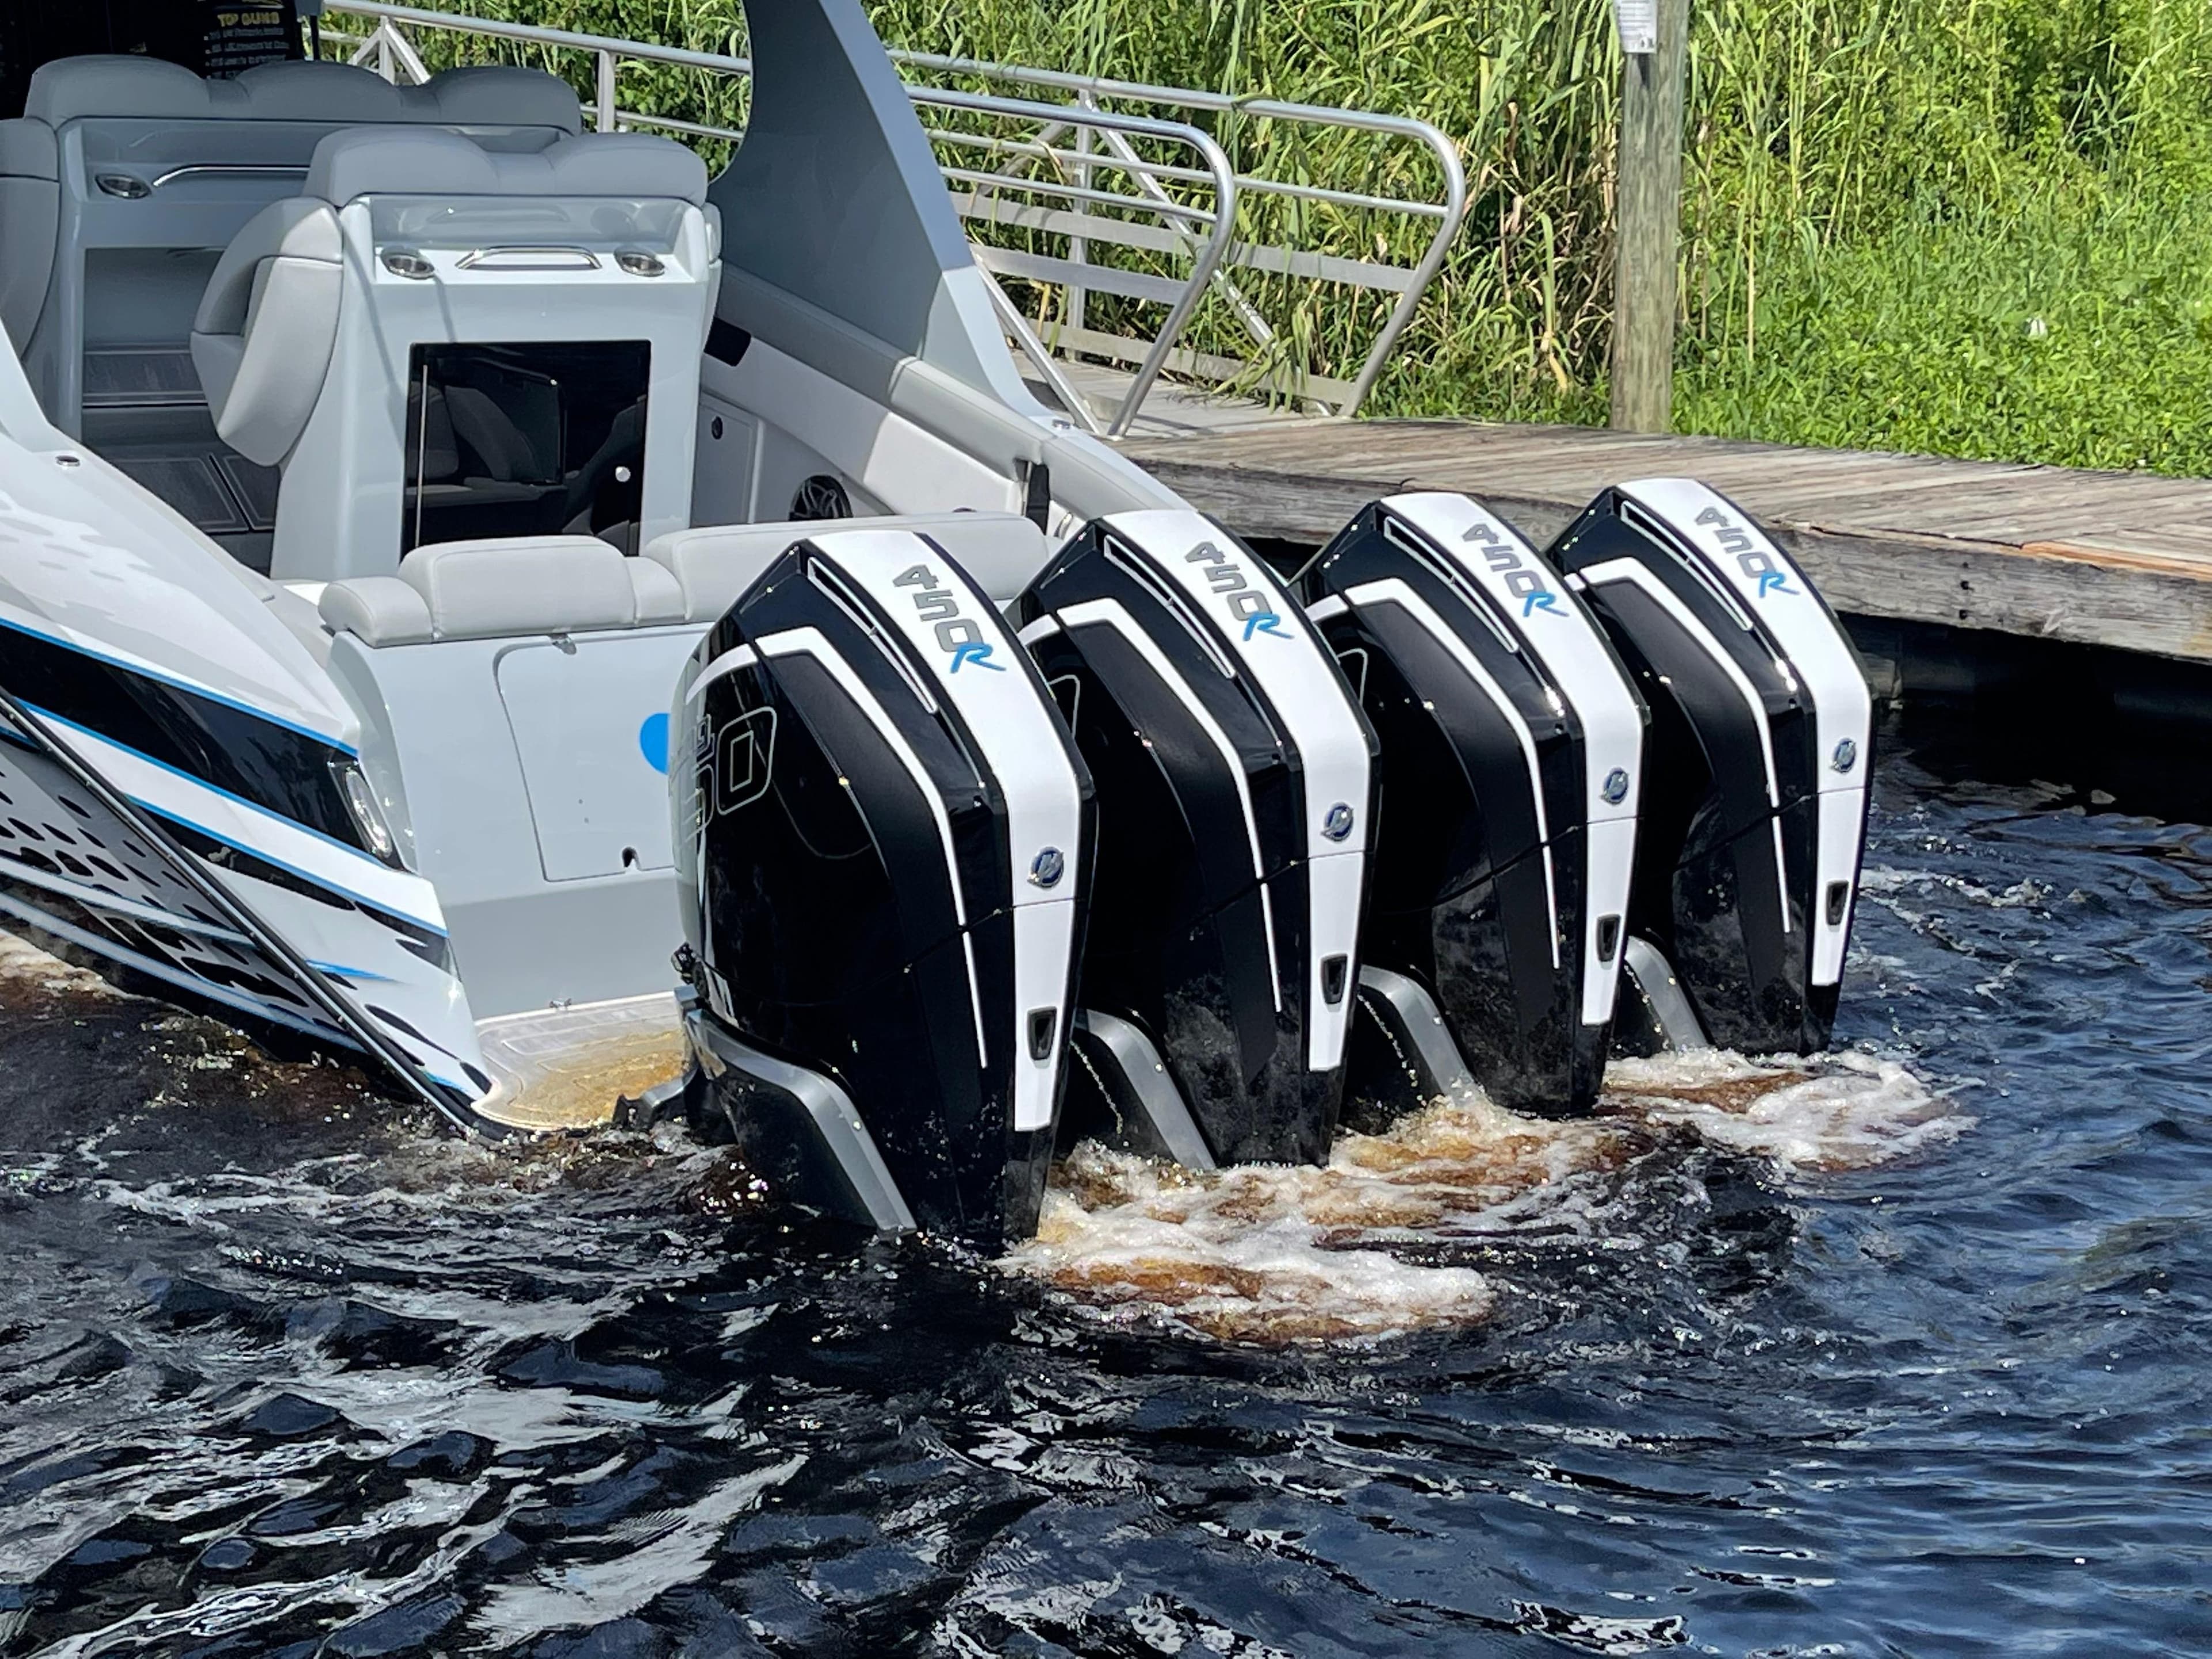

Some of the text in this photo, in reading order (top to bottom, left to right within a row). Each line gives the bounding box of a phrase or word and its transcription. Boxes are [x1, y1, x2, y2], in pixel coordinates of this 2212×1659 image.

[217, 13, 239, 26] TOP
[1184, 541, 1294, 641] 450R
[1461, 523, 1570, 618] 450R
[1695, 506, 1800, 598] 450R
[892, 564, 1006, 673] 450R
